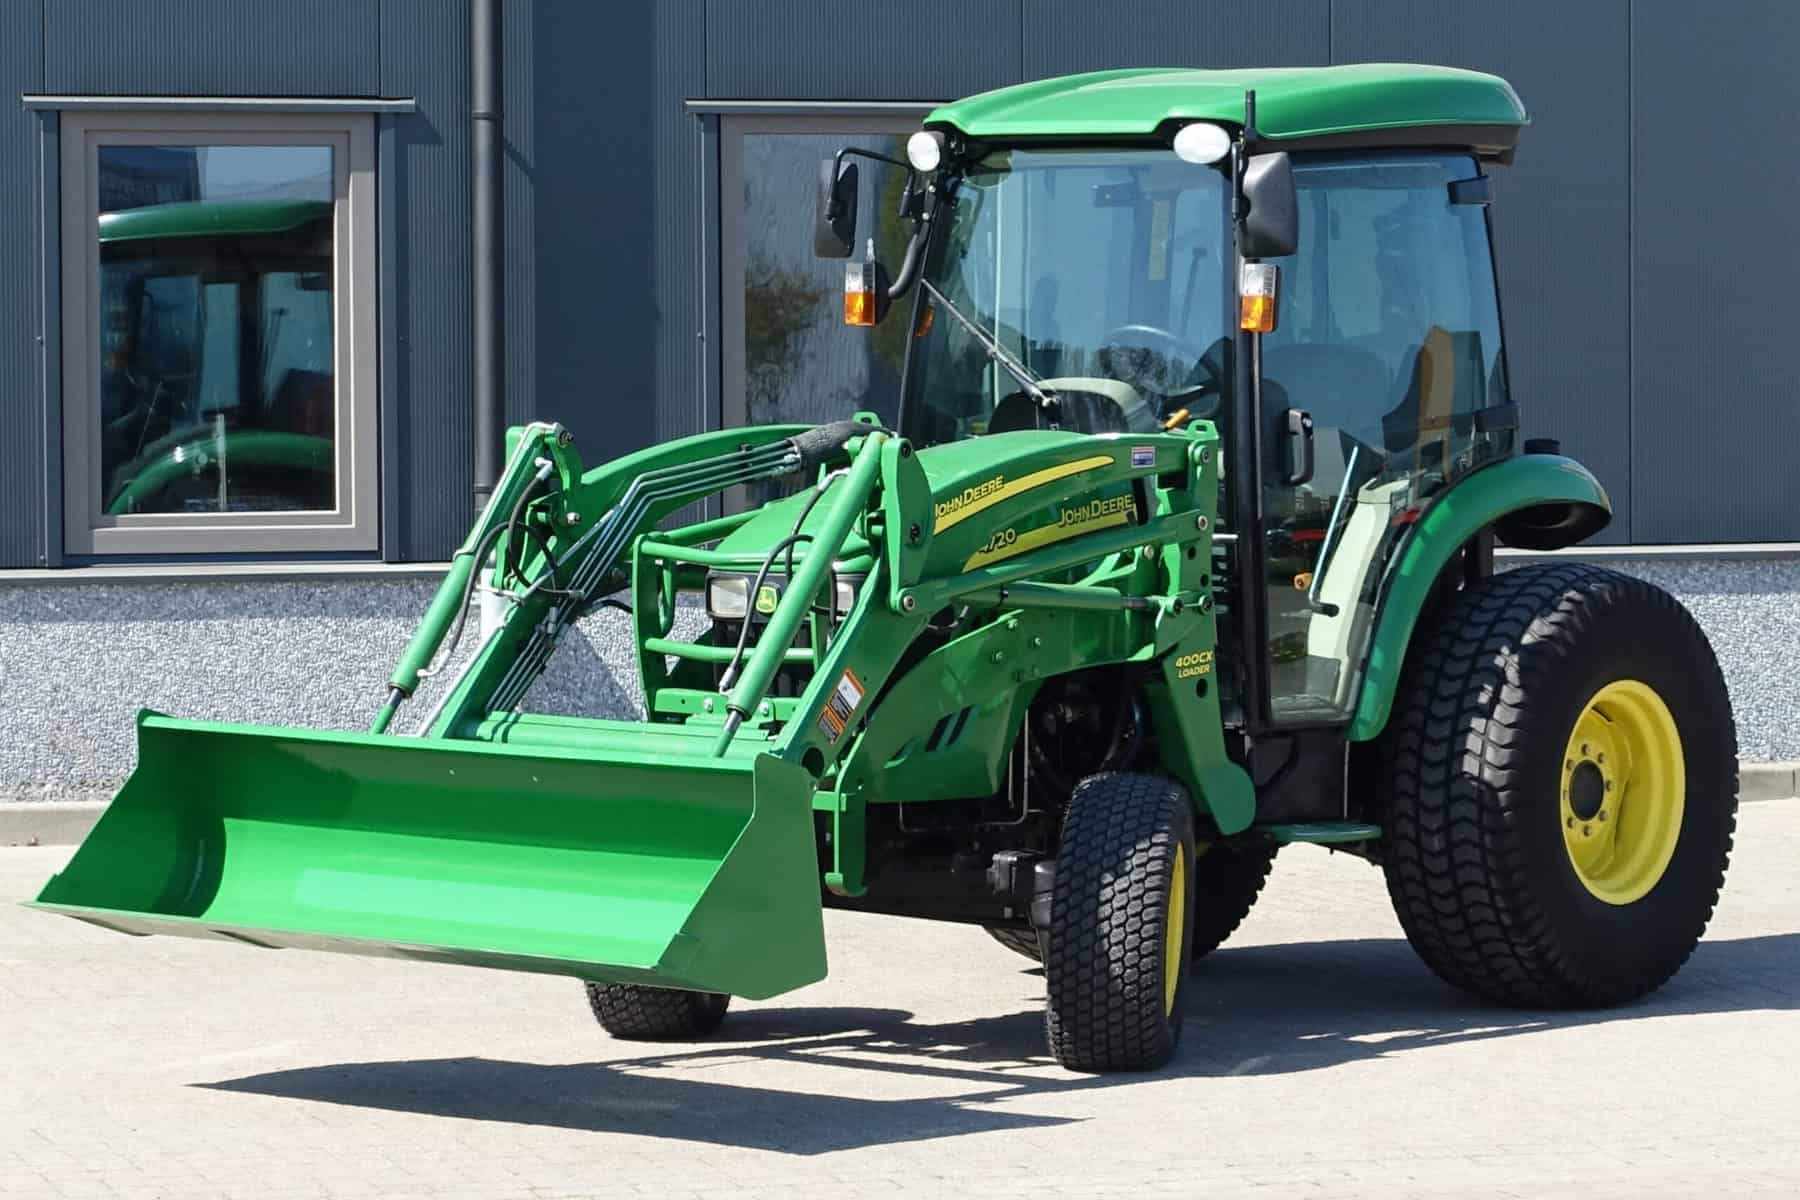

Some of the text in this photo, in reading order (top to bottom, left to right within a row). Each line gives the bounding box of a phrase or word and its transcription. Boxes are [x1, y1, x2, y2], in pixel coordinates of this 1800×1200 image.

[963, 475, 1004, 505] DEERE
[1059, 494, 1133, 526] JOHN DEERE
[1175, 651, 1213, 667] 400CX
[1178, 664, 1210, 678] LOADER
